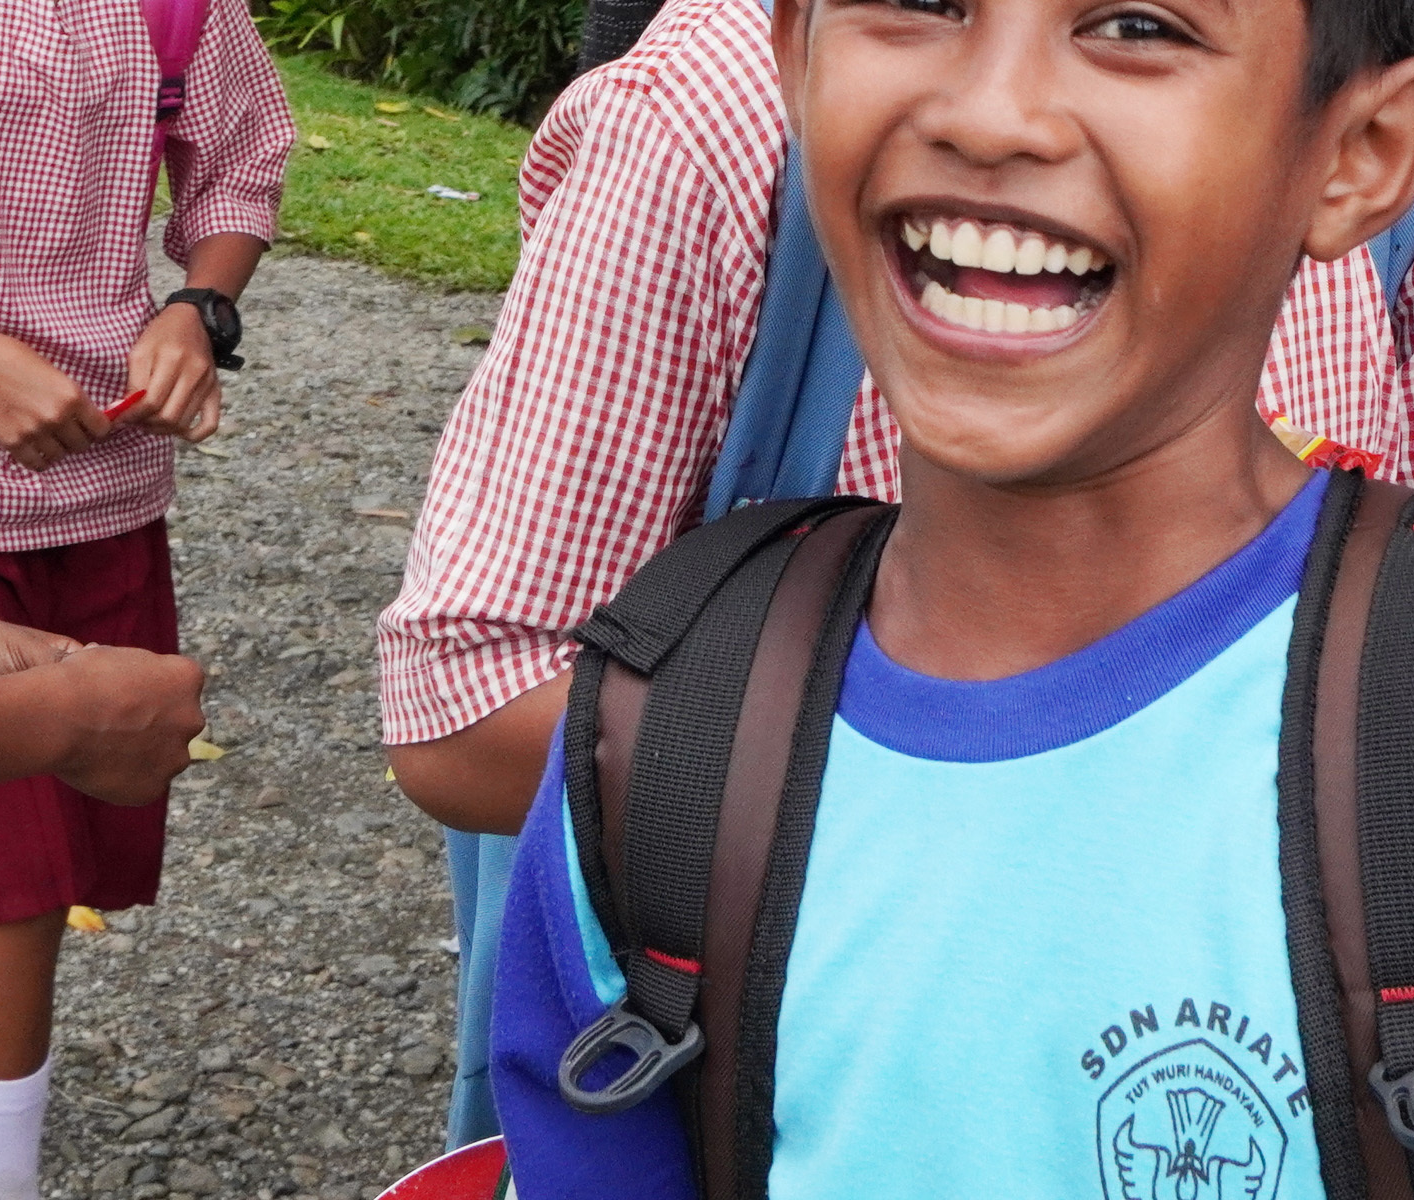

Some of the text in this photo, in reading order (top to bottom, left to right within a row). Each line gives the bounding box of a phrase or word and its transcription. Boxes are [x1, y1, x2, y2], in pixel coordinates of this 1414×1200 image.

[1081, 997, 1313, 1119] SDN ARIATE
[1151, 1064, 1191, 1085] WURI
[1195, 1065, 1265, 1129] HANDAYANI
